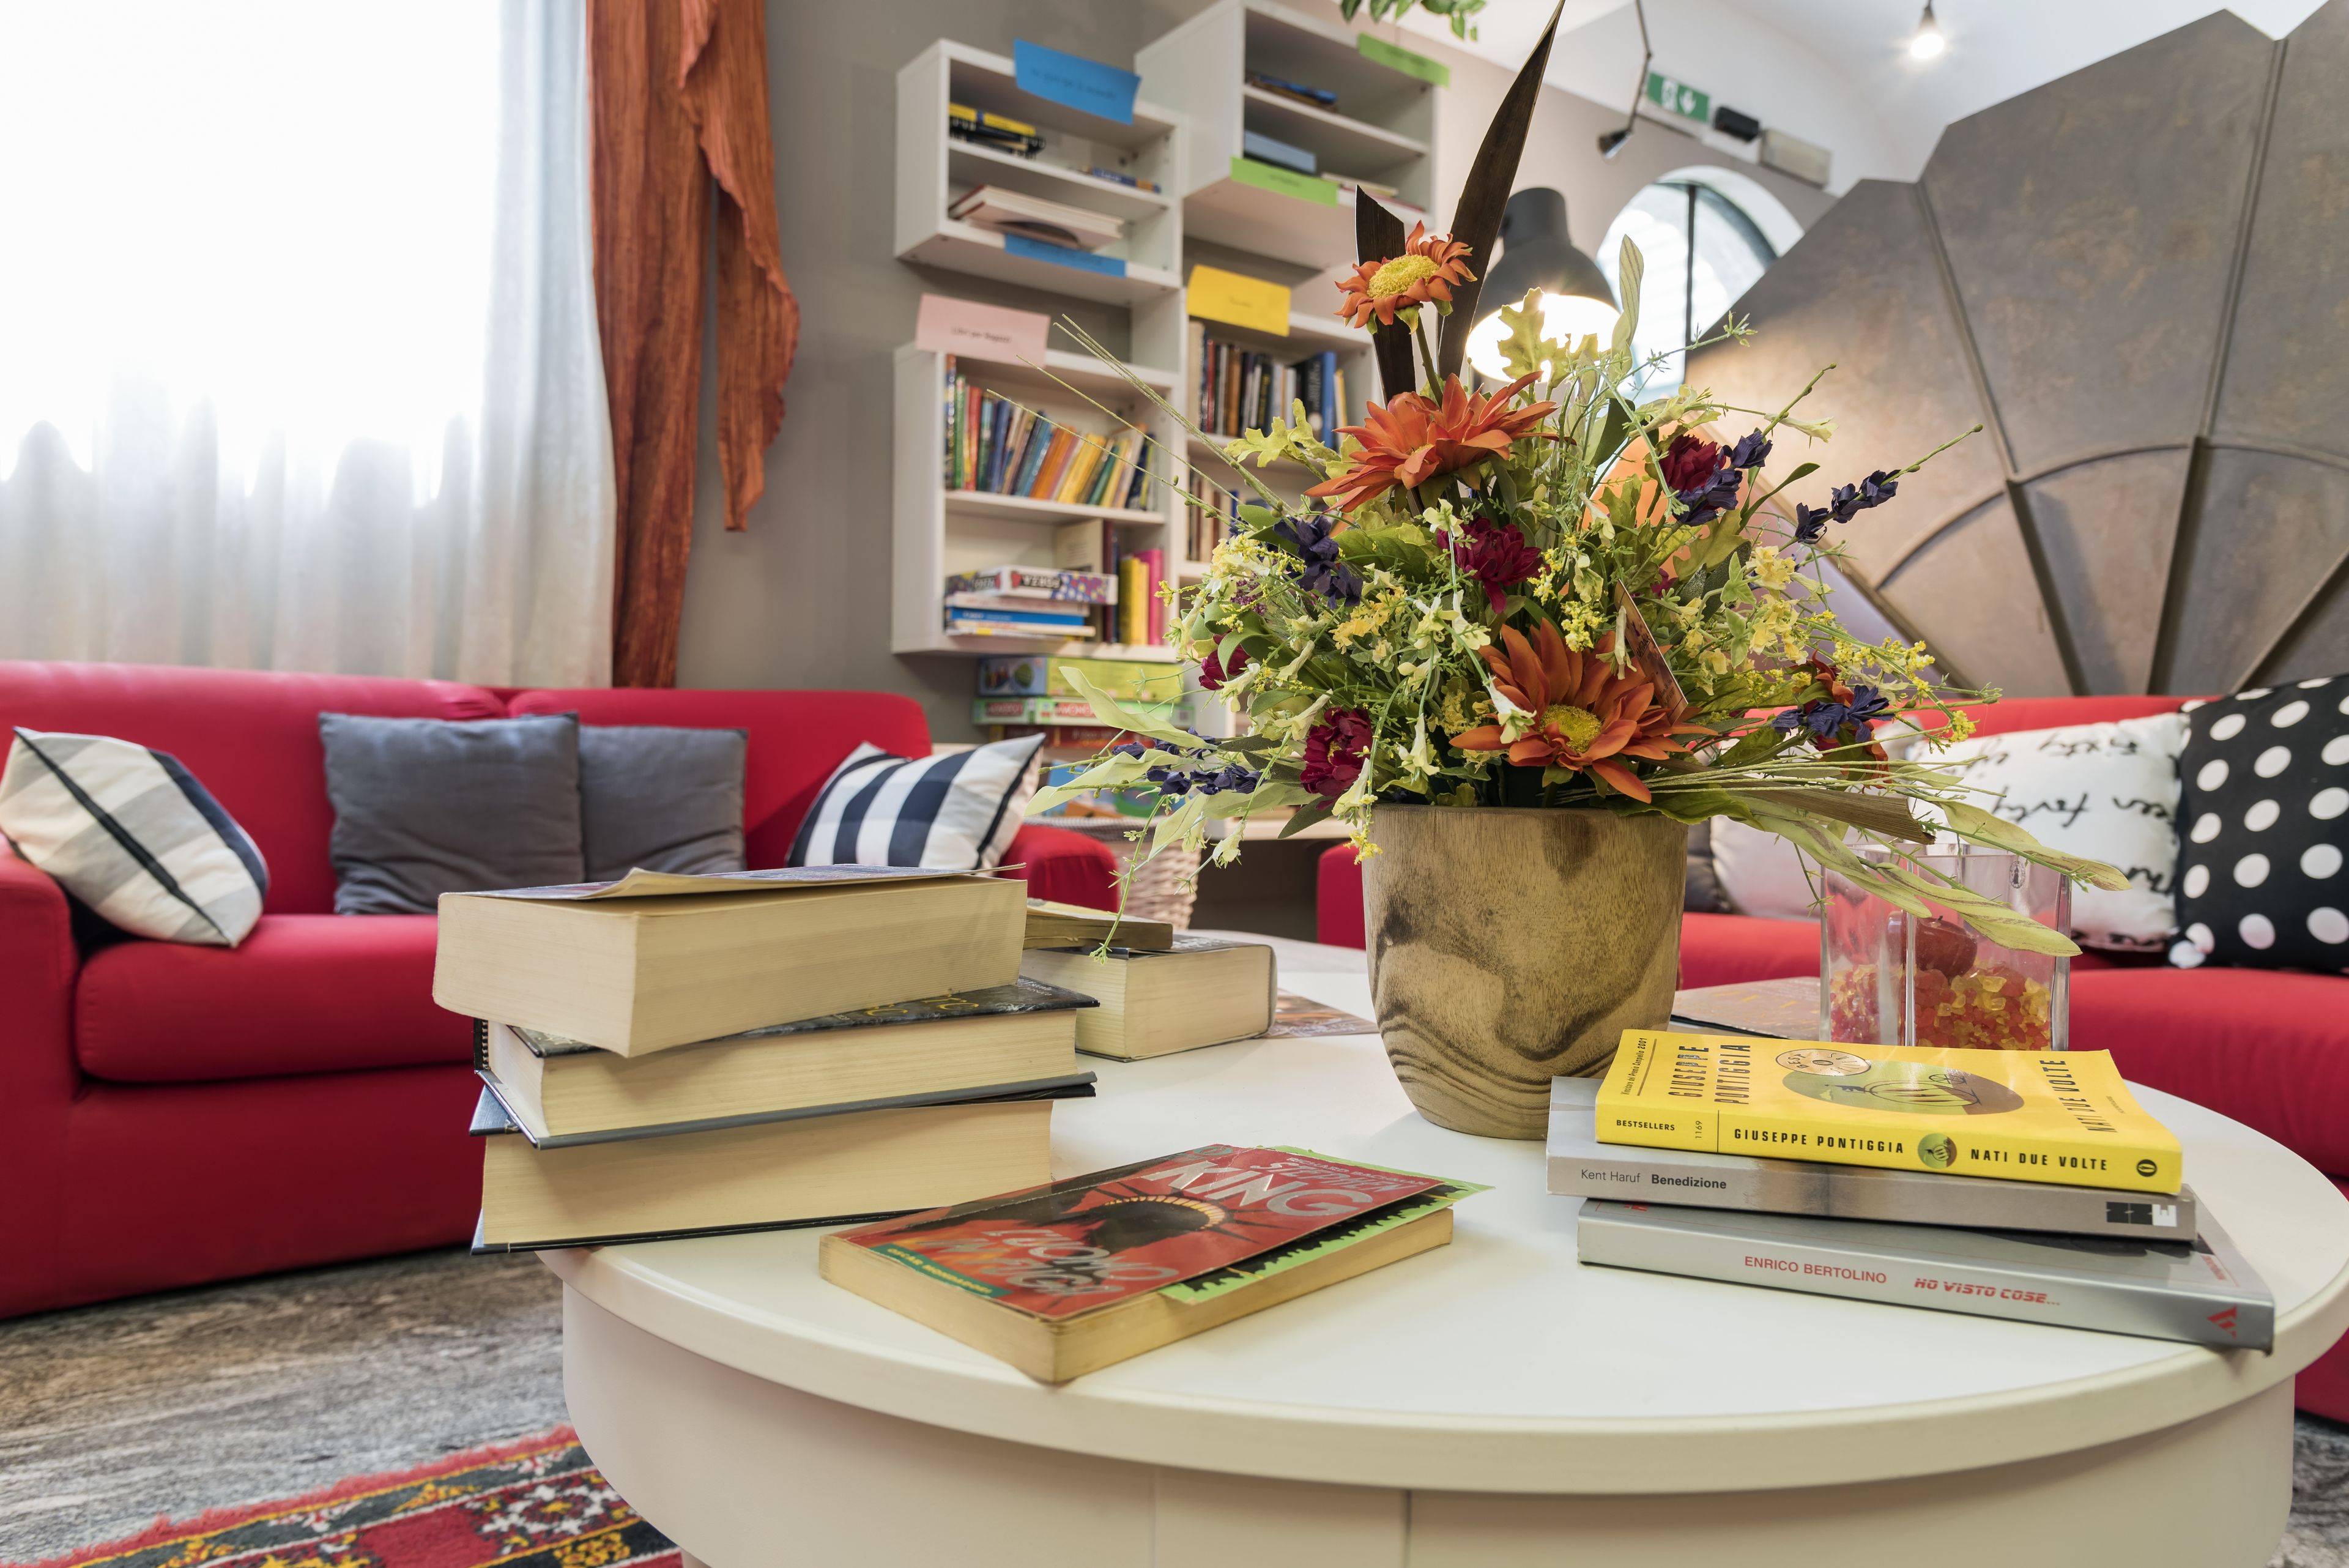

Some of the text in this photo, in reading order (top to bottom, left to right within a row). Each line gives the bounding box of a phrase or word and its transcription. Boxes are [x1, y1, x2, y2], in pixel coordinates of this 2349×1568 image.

[1638, 1038, 1647, 1049] 2001
[1668, 1046, 1709, 1098] GIUSEPPE
[1787, 1053, 1809, 1069] BEST
[1714, 1044, 1751, 1105] PONTIGGIA
[2039, 1060, 2080, 1092] VOLTE
[1617, 1119, 1675, 1131] BESTSELLERS
[1734, 1128, 1904, 1154] GIUSEPPE PONTIGGIA
[1286, 1157, 1349, 1173] RICHARD
[1971, 1148, 2107, 1171] NATI DUE VOLTE
[1141, 1160, 1373, 1216] KING
[1250, 1162, 1417, 1192] STEPHEN
[1581, 1169, 1727, 1189] Kent Haruf Benedizione
[1745, 1255, 1798, 1273] ENRICO
[1804, 1263, 1887, 1284] BERTOLINO
[1913, 1278, 1939, 1290] HO
[1943, 1280, 1996, 1297] VISTO
